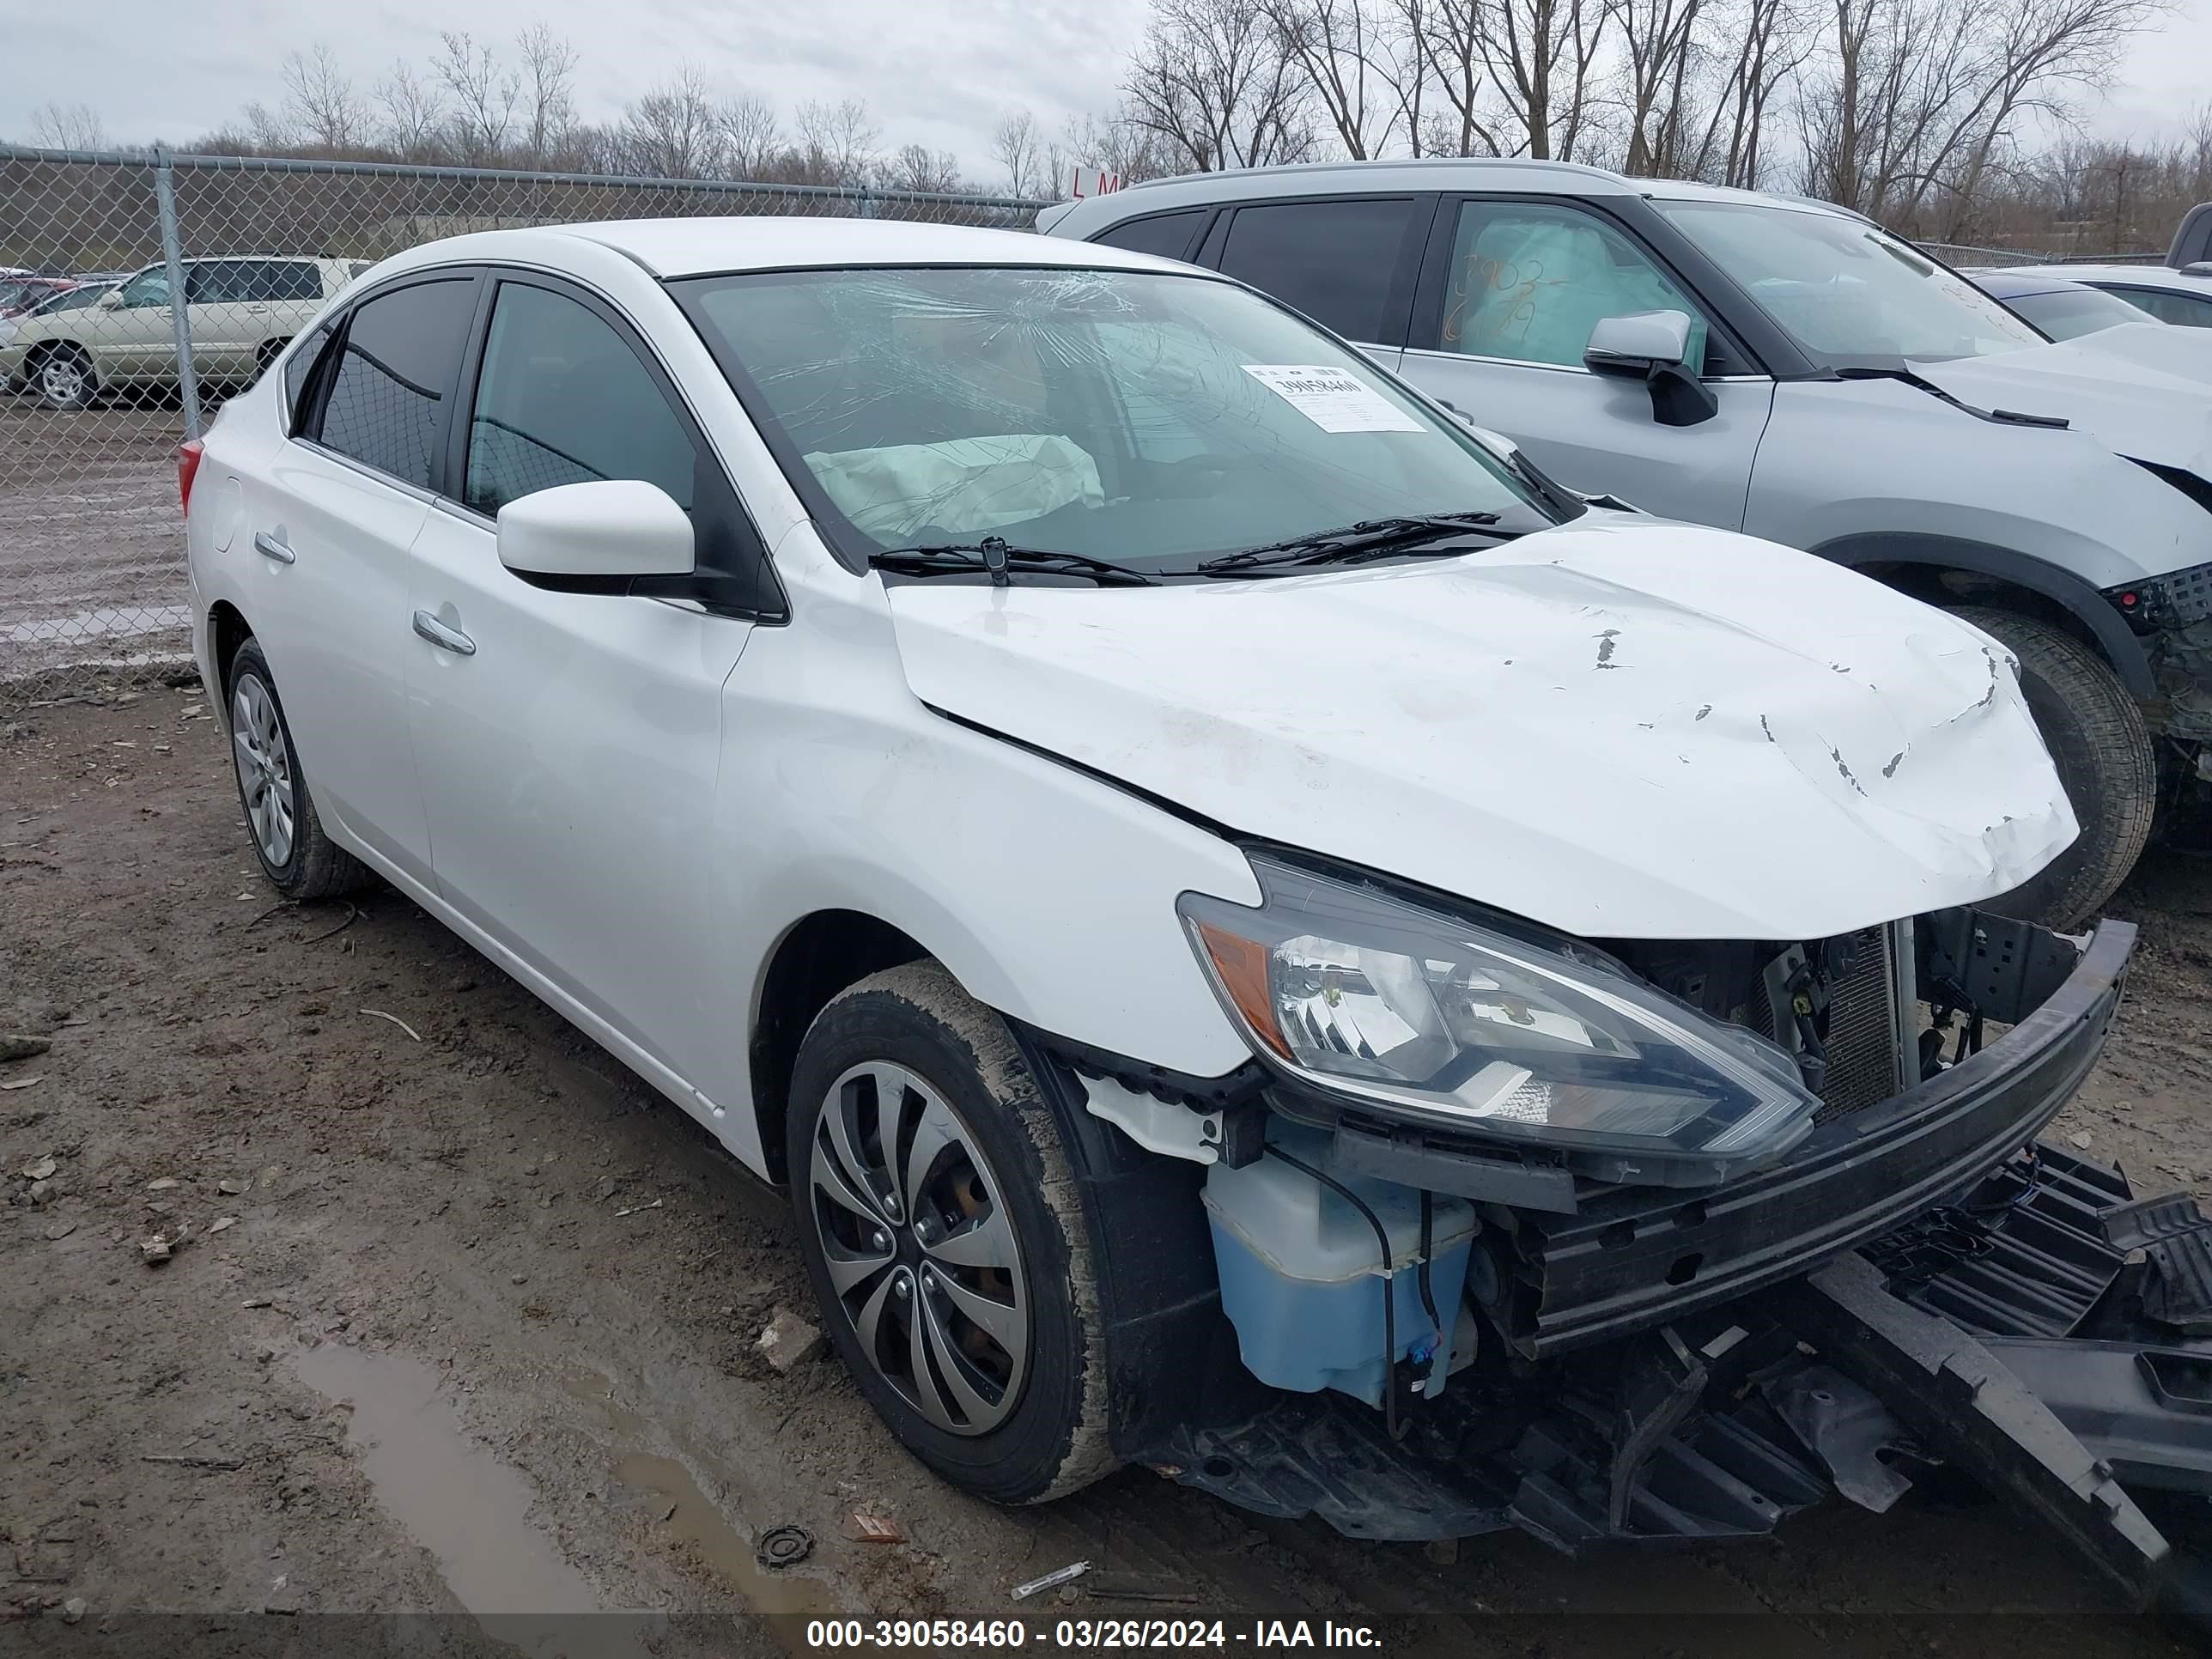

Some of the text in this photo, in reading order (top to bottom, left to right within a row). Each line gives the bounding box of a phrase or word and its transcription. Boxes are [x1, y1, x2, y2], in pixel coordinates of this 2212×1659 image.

[1073, 167, 1118, 198] L M
[1275, 379, 1363, 394] 39058460
